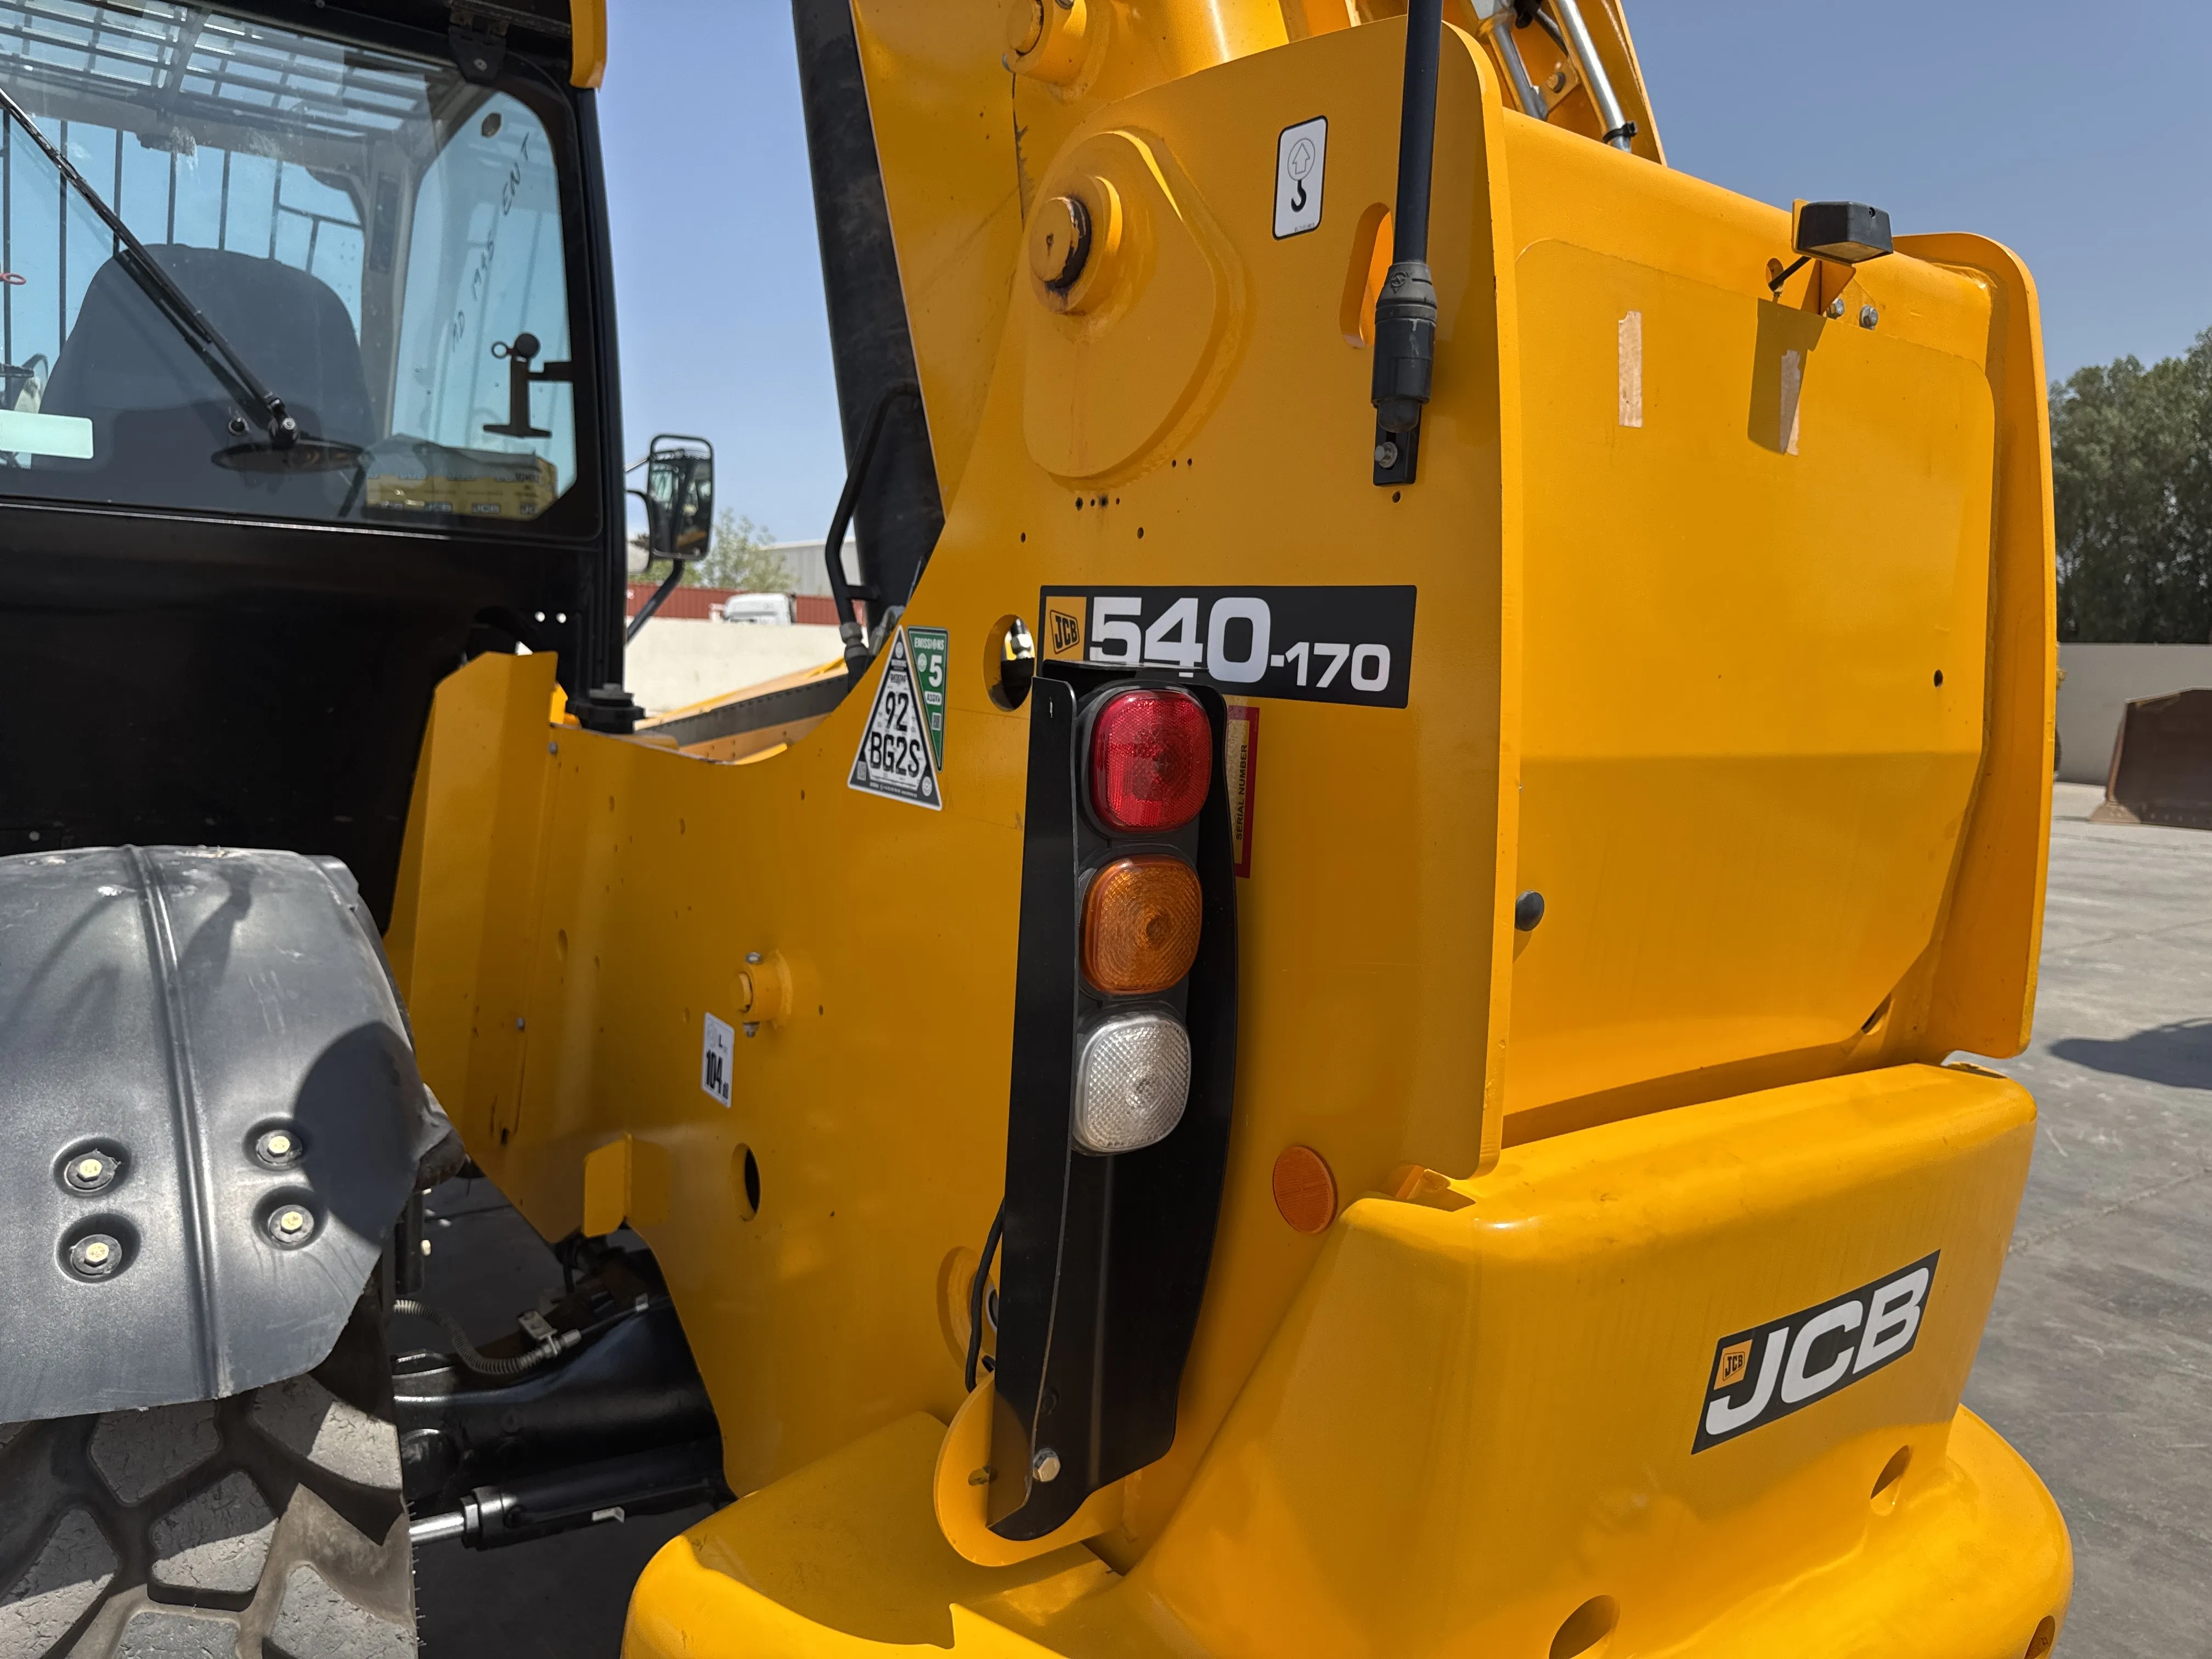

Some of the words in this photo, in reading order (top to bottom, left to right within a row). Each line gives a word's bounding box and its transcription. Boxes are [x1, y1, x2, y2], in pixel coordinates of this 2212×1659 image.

[1054, 615, 1079, 650] JCB
[928, 654, 943, 687] 5
[885, 692, 909, 732] 92
[870, 731, 921, 778] BG2S
[1238, 744, 1247, 795] NUMBER
[1235, 798, 1244, 840] SERIAL
[706, 1049, 723, 1094] 104
[1705, 1267, 1929, 1435] JCB
[1724, 1353, 1745, 1376] JCB
